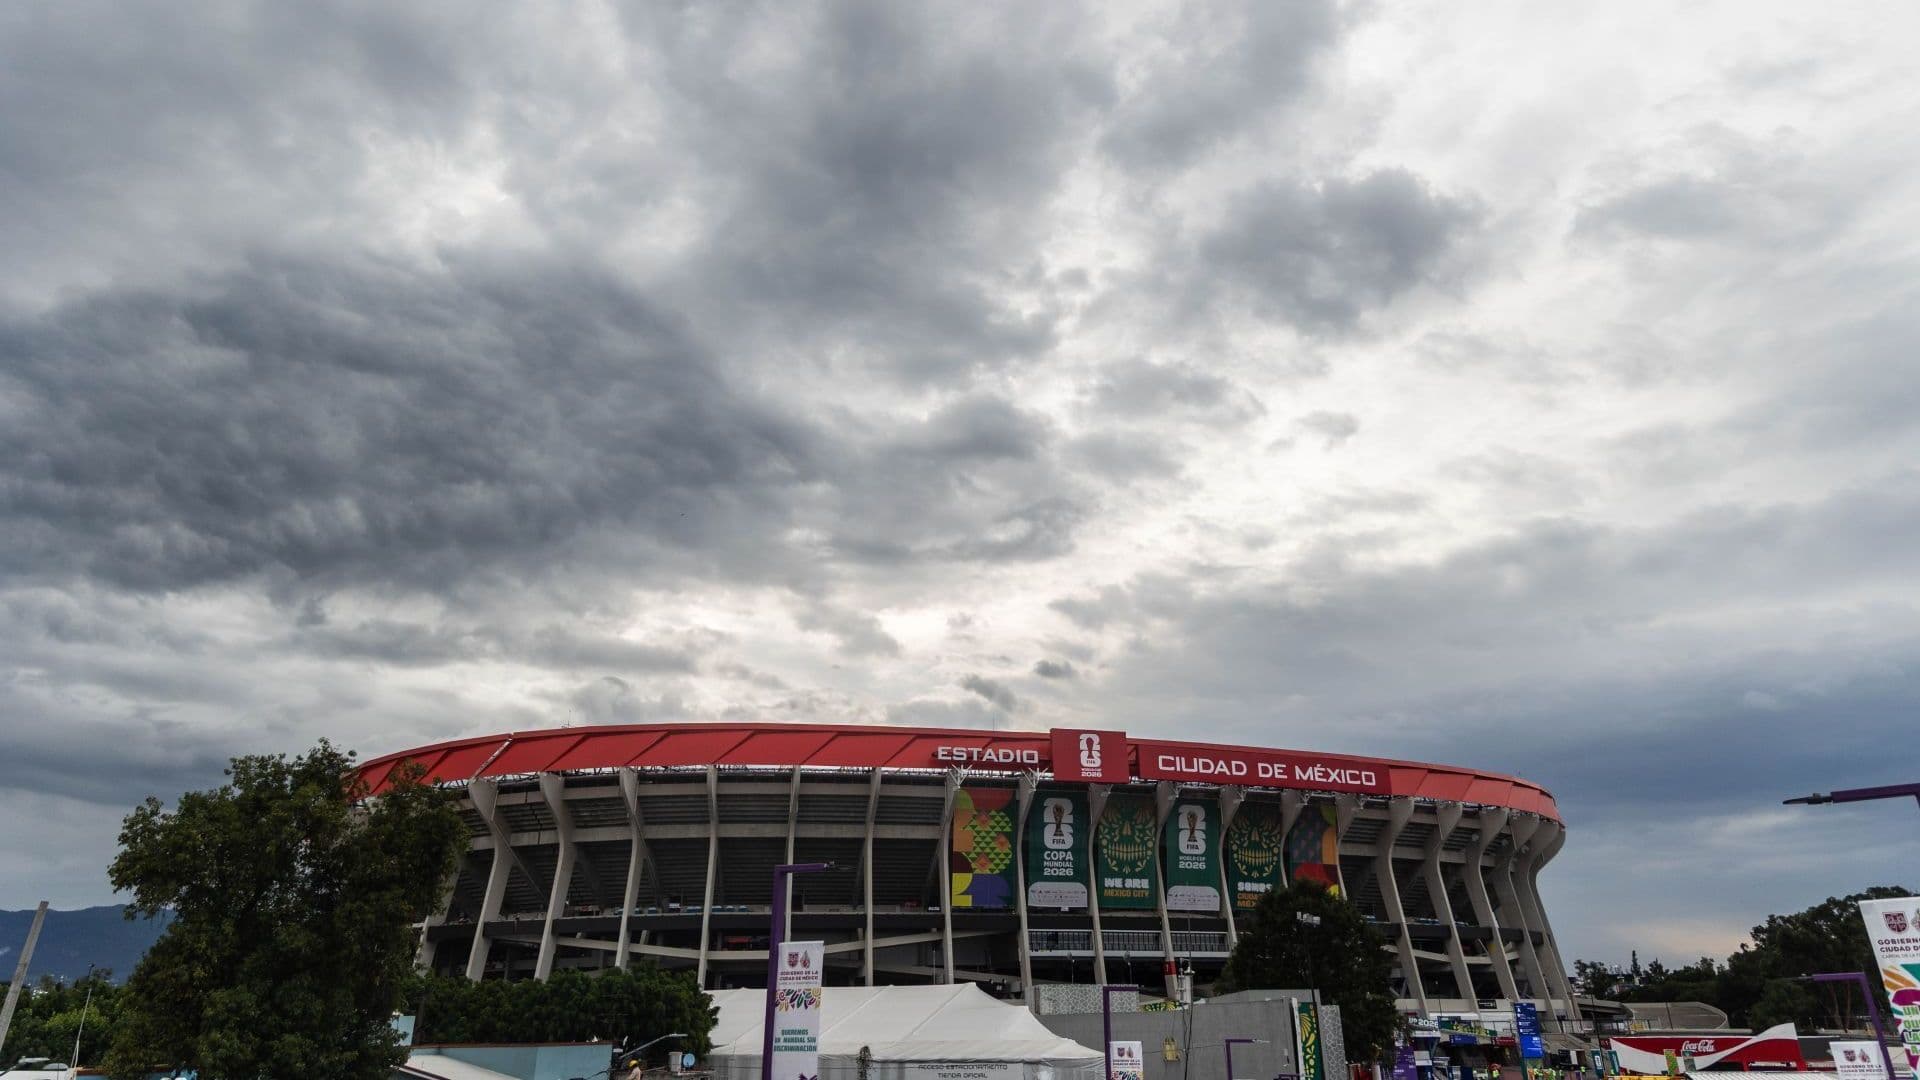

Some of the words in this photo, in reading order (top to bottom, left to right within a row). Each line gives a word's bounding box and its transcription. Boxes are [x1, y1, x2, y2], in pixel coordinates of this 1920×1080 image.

[937, 746, 1040, 764] ESTADIO
[1158, 755, 1248, 776] CIUDAD
[1258, 763, 1288, 779] DE
[1295, 764, 1377, 786] MÉXICO
[1043, 850, 1074, 861] COPA
[1043, 860, 1074, 868] MUNDIAL
[1178, 861, 1207, 870] 2026
[1043, 868, 1074, 877] 2026
[1104, 877, 1123, 888] WE
[1103, 888, 1131, 897] MEXICO
[1877, 937, 1920, 946] GOBIERN
